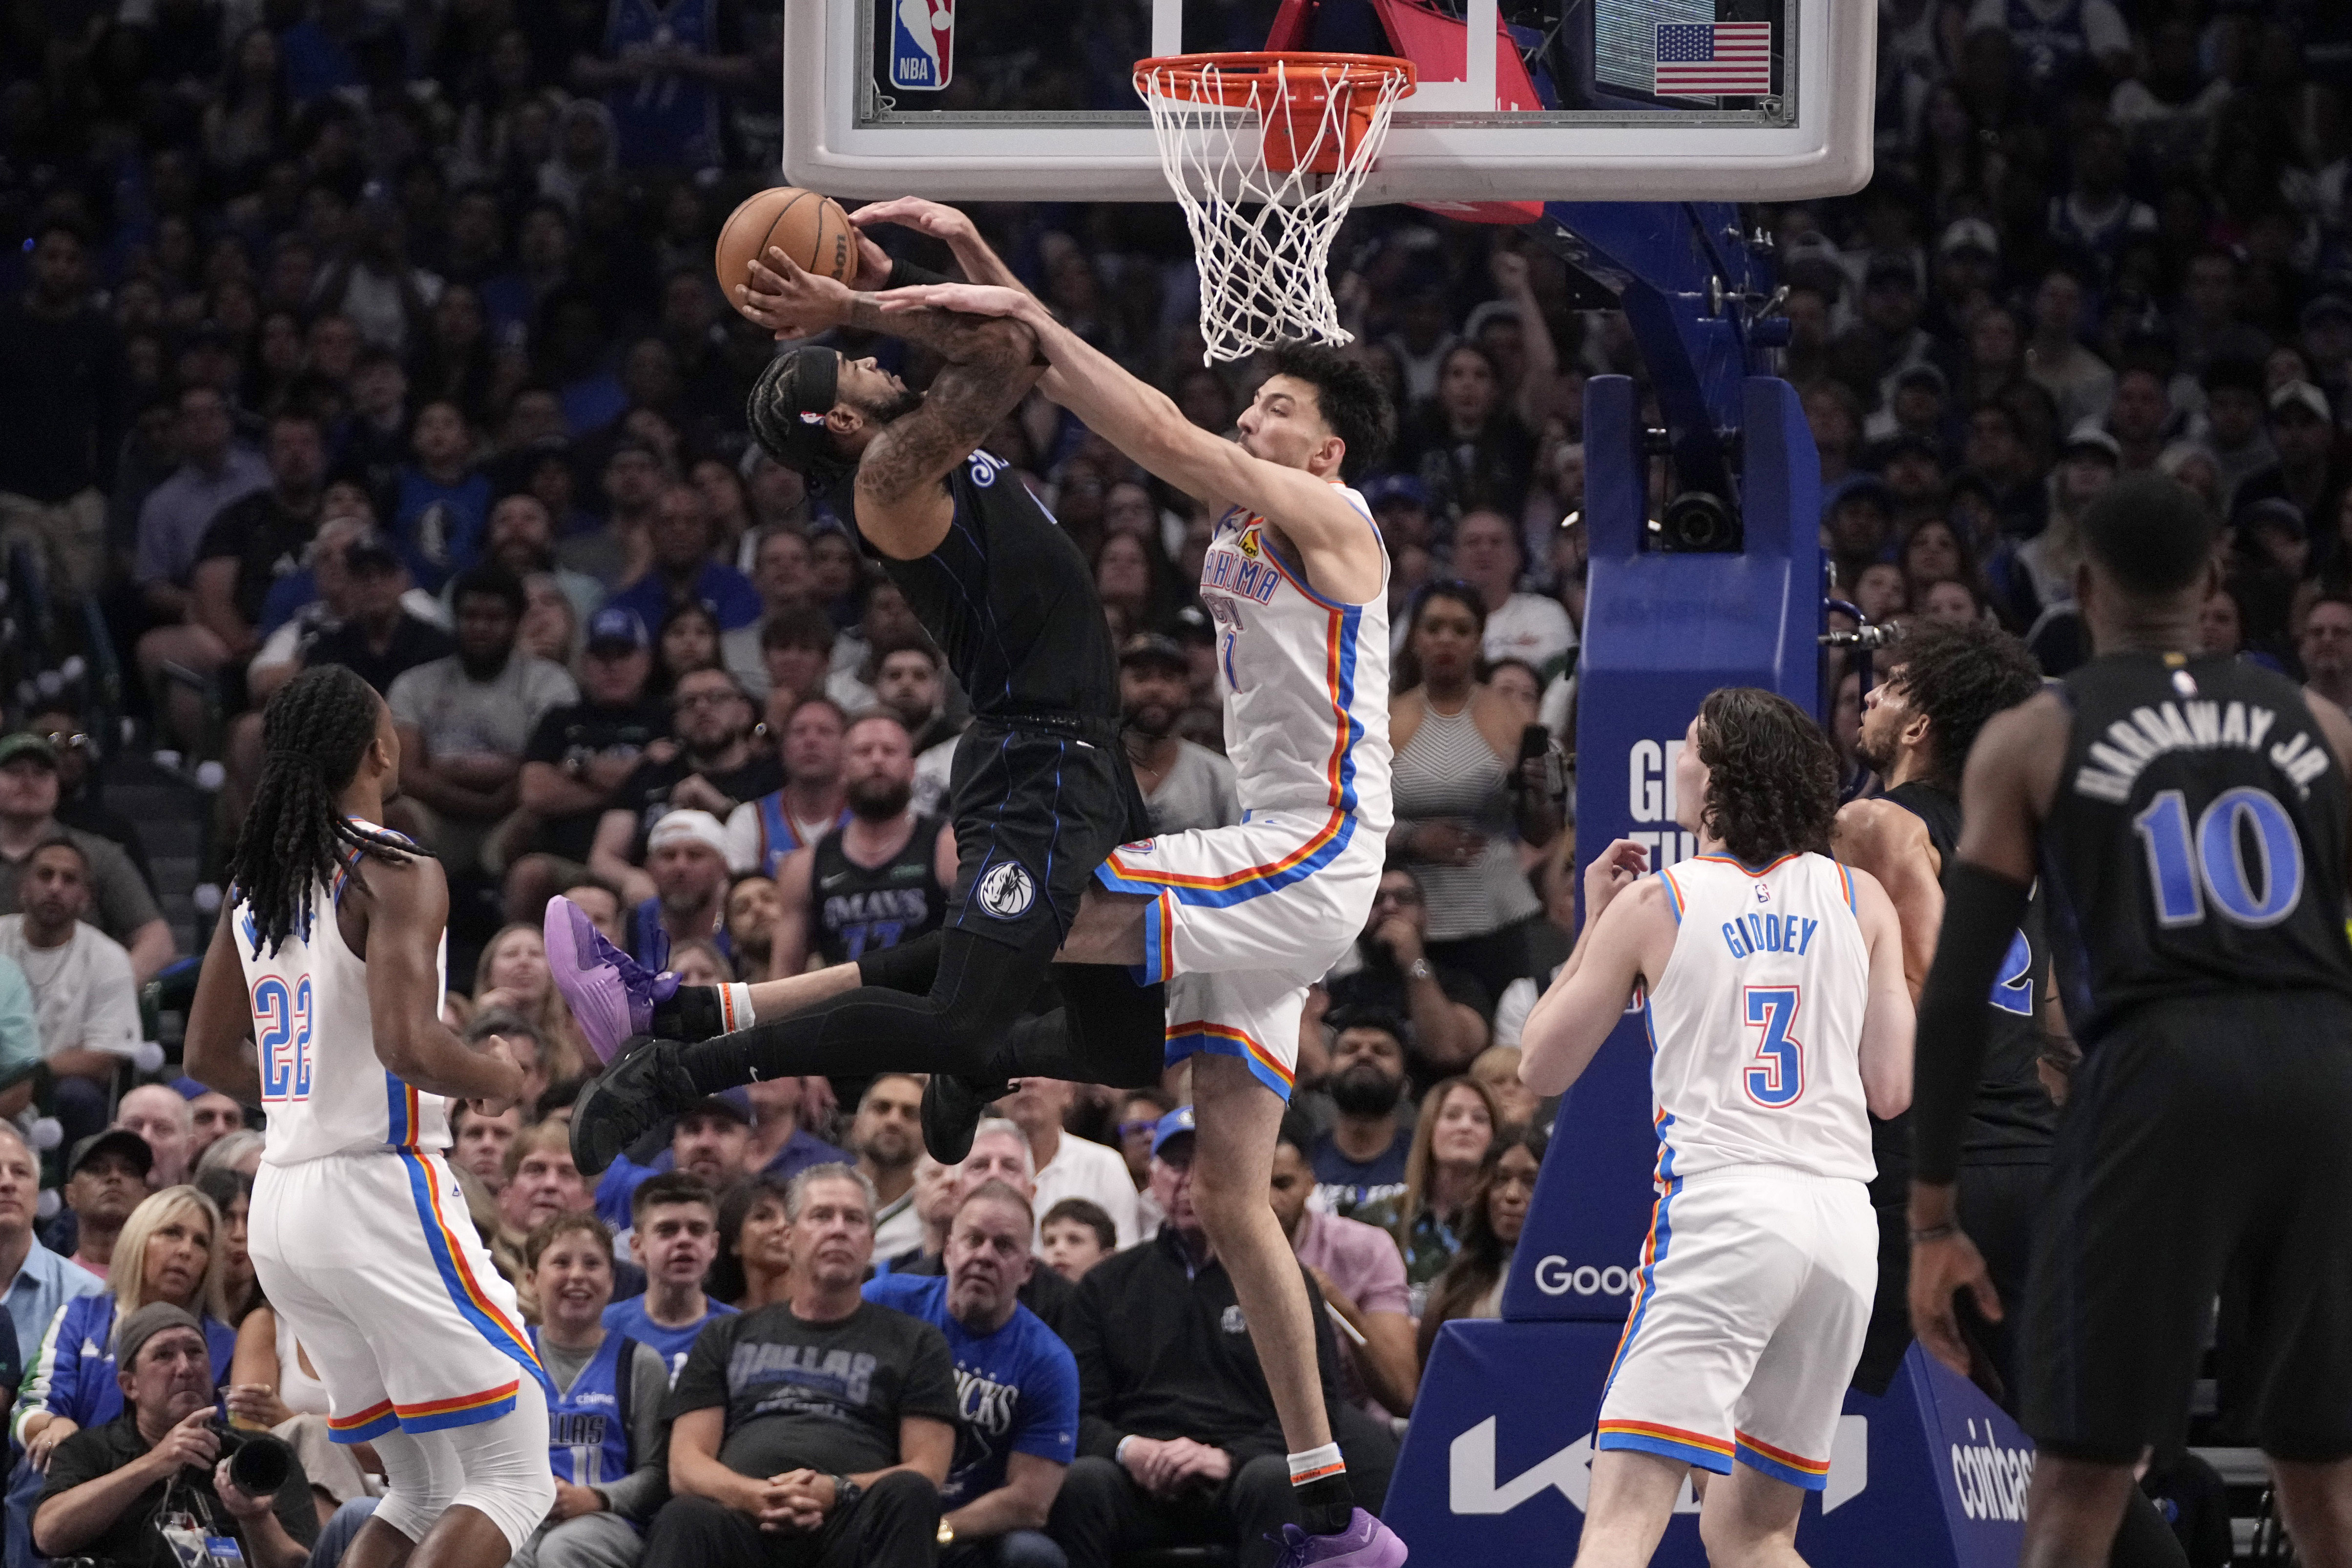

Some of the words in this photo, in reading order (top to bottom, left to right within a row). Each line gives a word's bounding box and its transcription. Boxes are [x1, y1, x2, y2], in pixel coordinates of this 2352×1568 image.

[899, 57, 928, 80] NBA
[1200, 549, 1282, 606] AHOMA
[2074, 699, 2276, 806] HARDAWAY
[2269, 731, 2331, 802] JR.
[2131, 784, 2306, 930] 10
[1722, 913, 1819, 959] GIDDEY
[250, 972, 313, 1102] 22
[1743, 984, 1805, 1109] 3
[726, 1341, 878, 1406] DALLAS
[548, 1412, 608, 1446] LLAS
